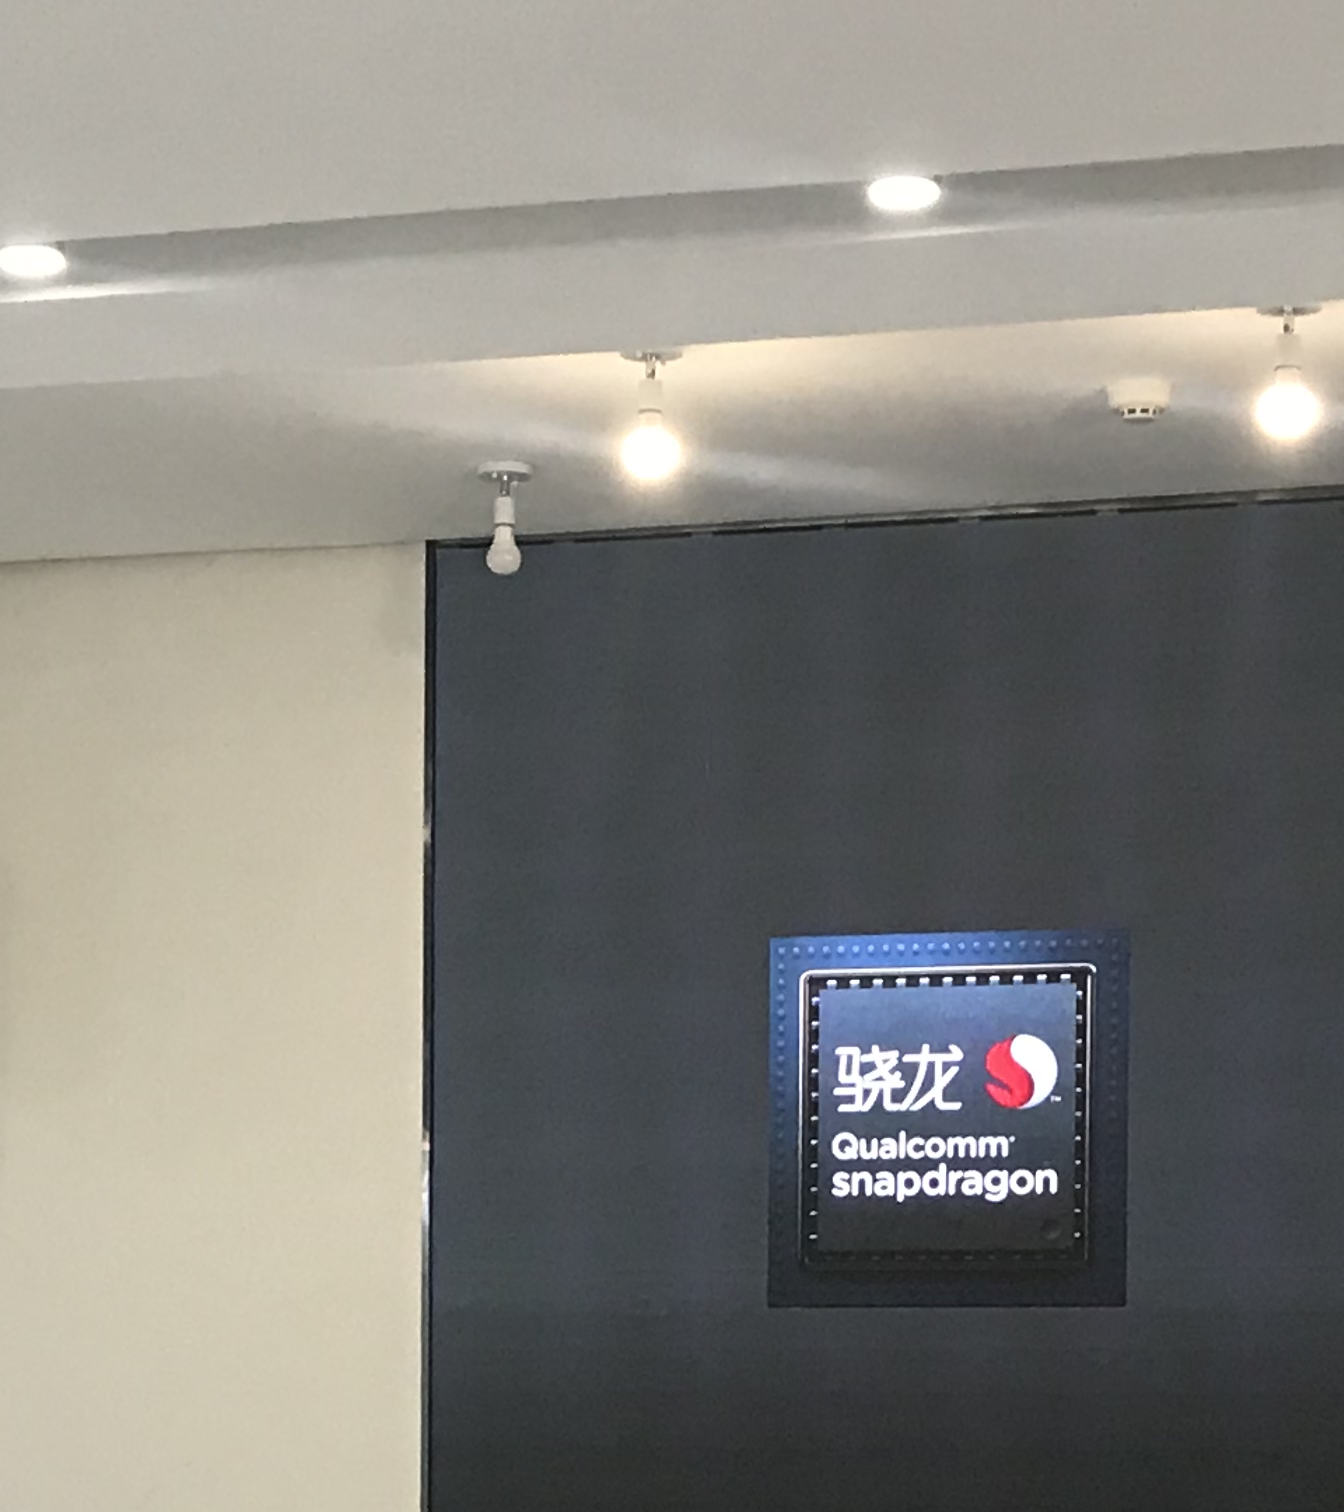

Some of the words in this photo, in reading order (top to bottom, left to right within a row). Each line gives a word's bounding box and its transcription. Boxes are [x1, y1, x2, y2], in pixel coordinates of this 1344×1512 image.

[832, 1043, 964, 1113] 骁龙
[830, 1130, 1011, 1161] Qualcomm
[830, 1162, 1058, 1203] snapdragon
